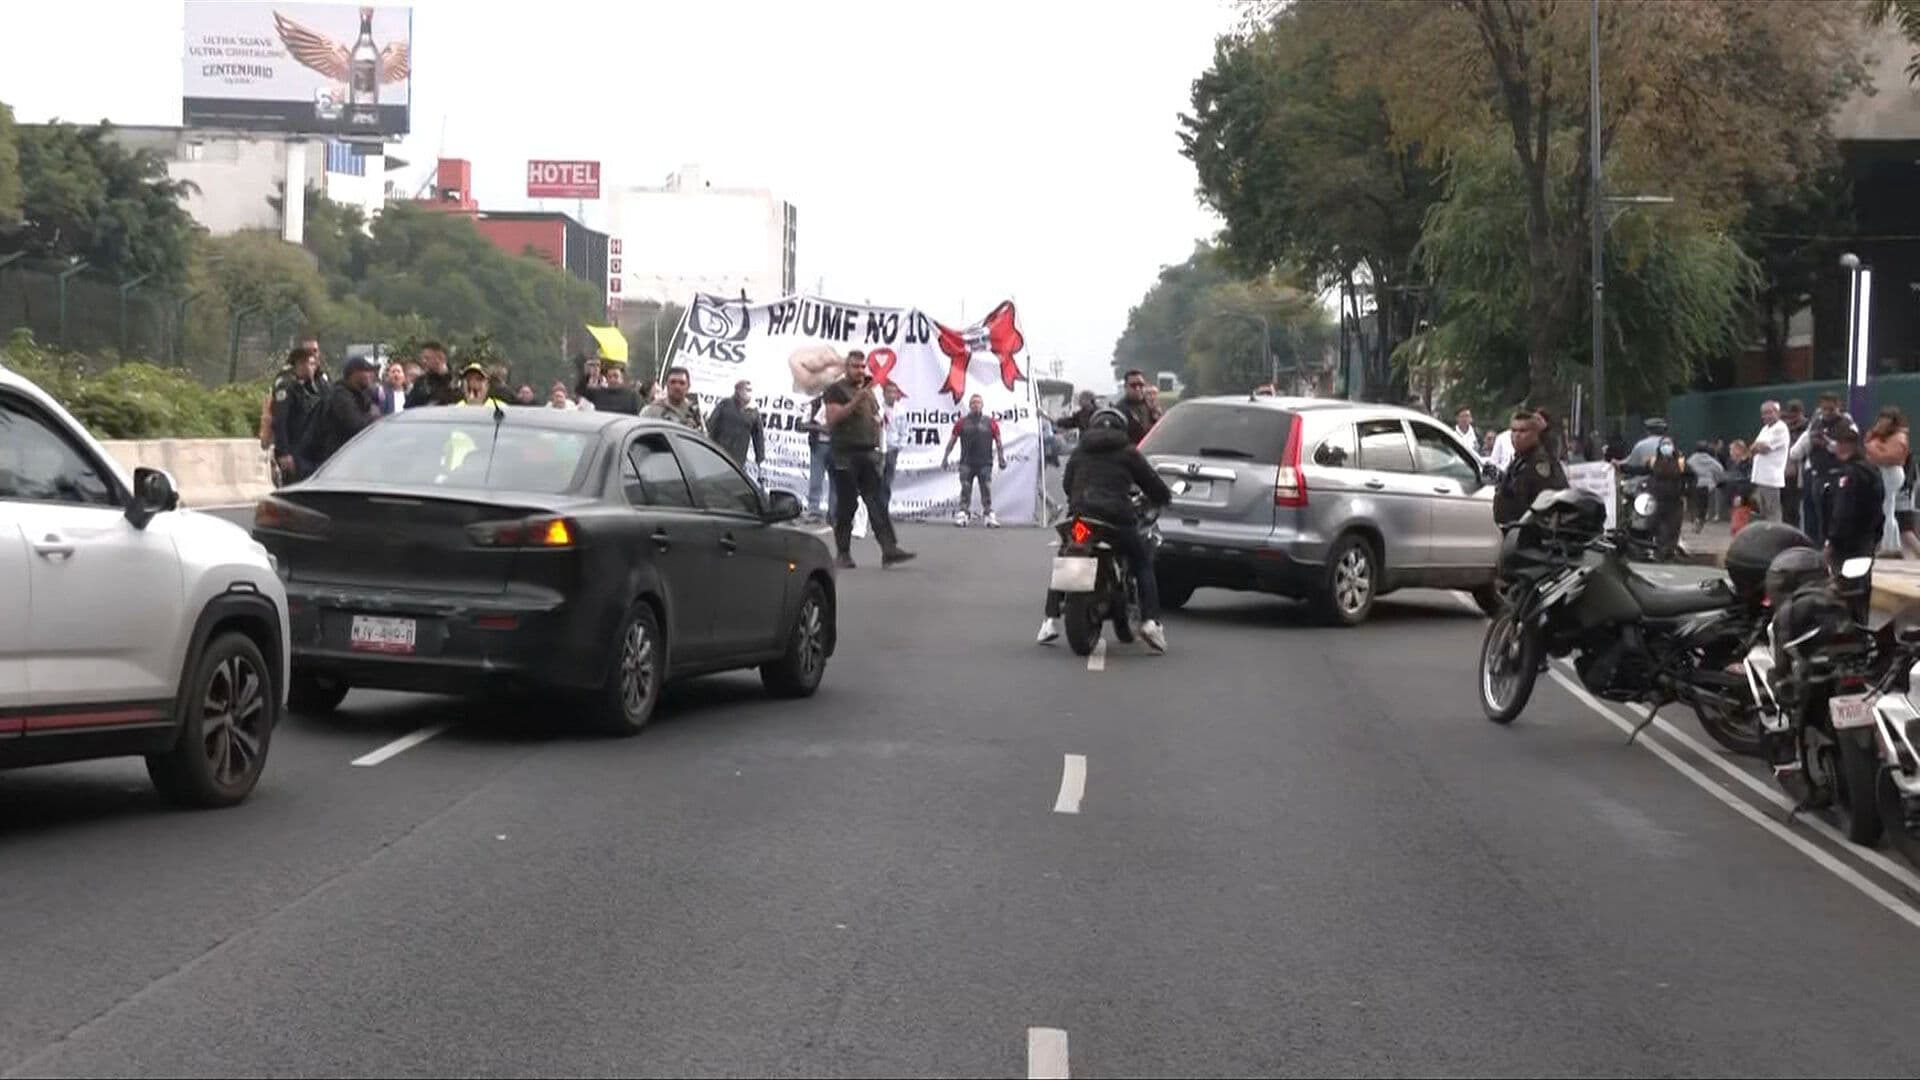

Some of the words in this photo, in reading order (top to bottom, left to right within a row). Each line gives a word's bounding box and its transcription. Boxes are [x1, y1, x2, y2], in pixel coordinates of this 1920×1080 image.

[529, 162, 598, 185] HOTEL
[768, 301, 858, 343] HP/UMF
[865, 310, 899, 345] NO
[904, 312, 931, 345] 10
[678, 331, 746, 364] IMSS
